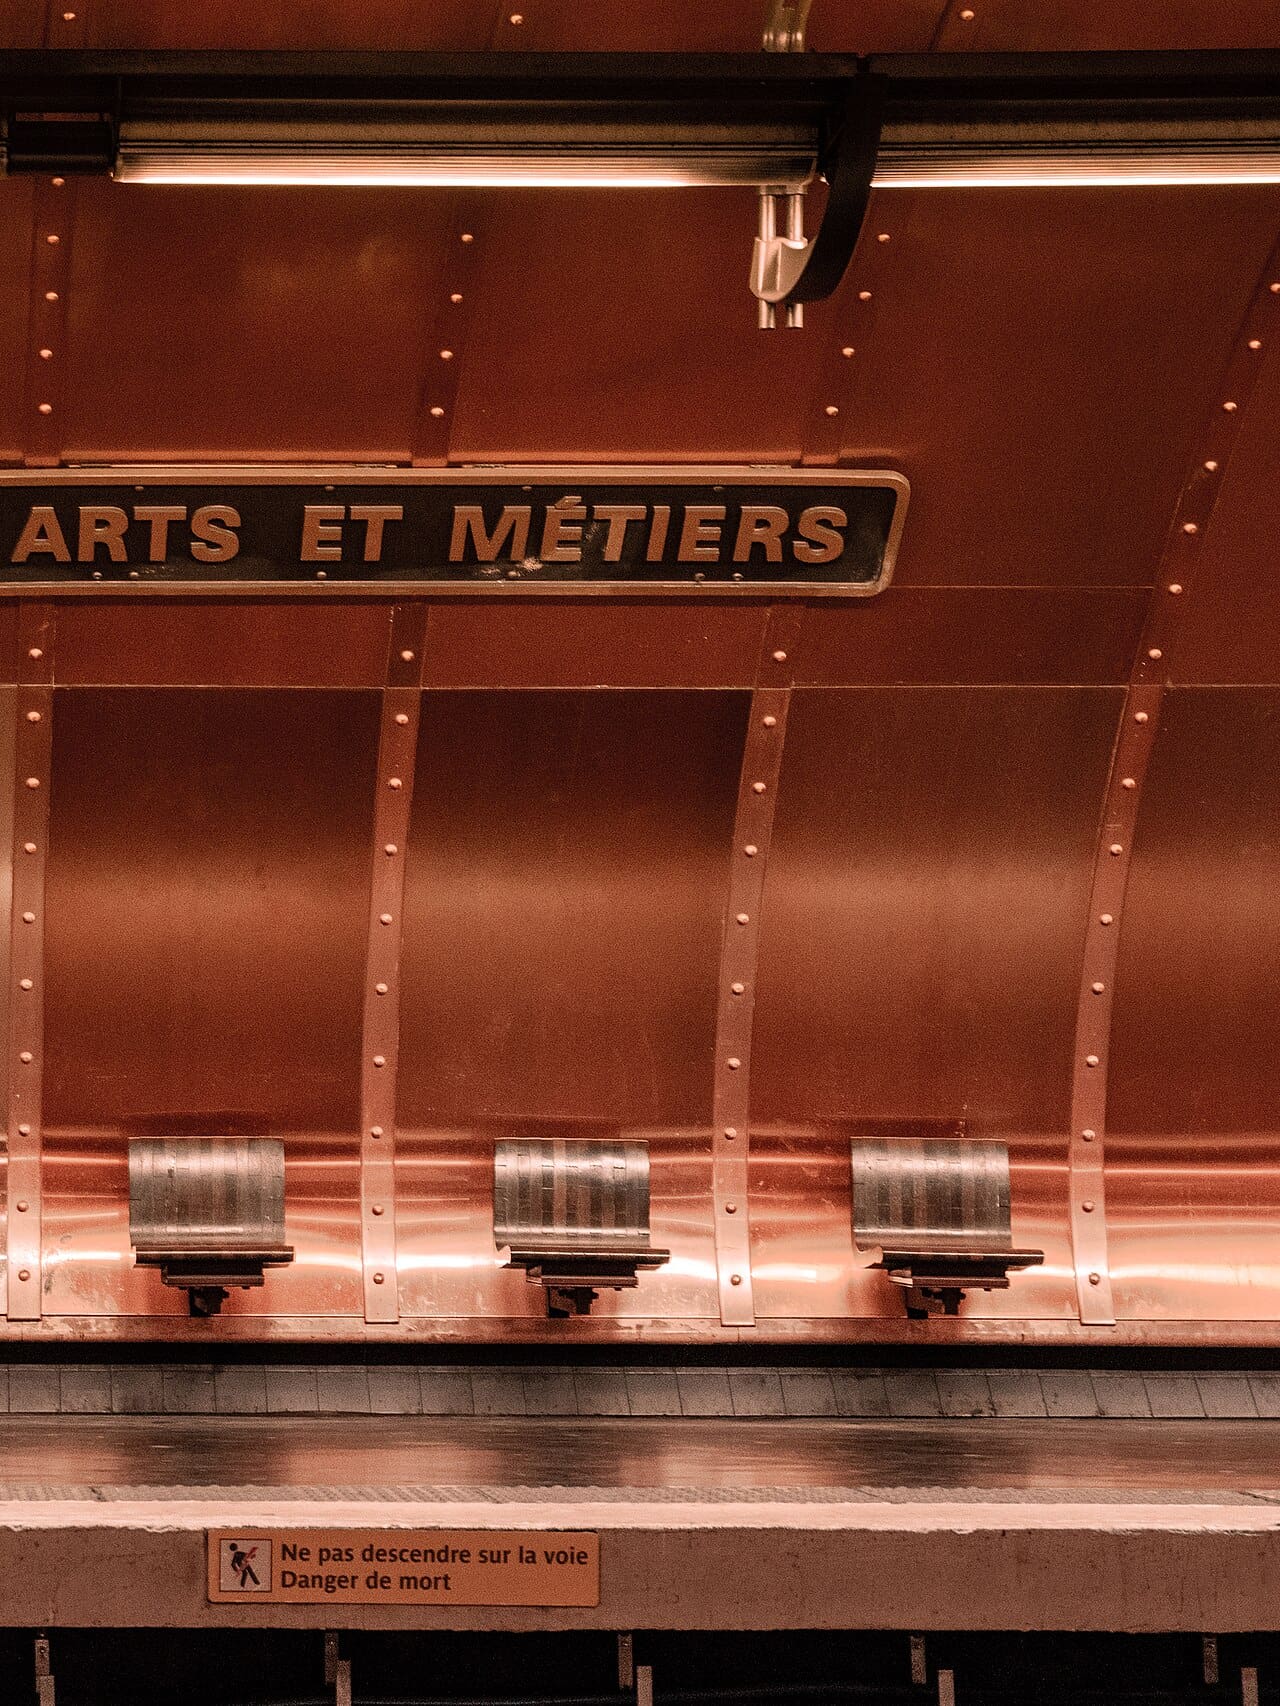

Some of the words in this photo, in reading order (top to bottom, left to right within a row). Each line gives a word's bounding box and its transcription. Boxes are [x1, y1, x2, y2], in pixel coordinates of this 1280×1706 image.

[11, 504, 242, 564] ARTS
[301, 504, 403, 563] ET
[449, 495, 847, 564] MÉTIERS
[281, 1543, 311, 1562] Ne
[319, 1548, 354, 1567] pas
[362, 1544, 471, 1564] descendre
[478, 1549, 511, 1564] sur
[519, 1545, 537, 1564] la
[544, 1546, 588, 1565] voie
[281, 1570, 358, 1593] Danger
[365, 1571, 392, 1590] de
[399, 1573, 451, 1591] mort
